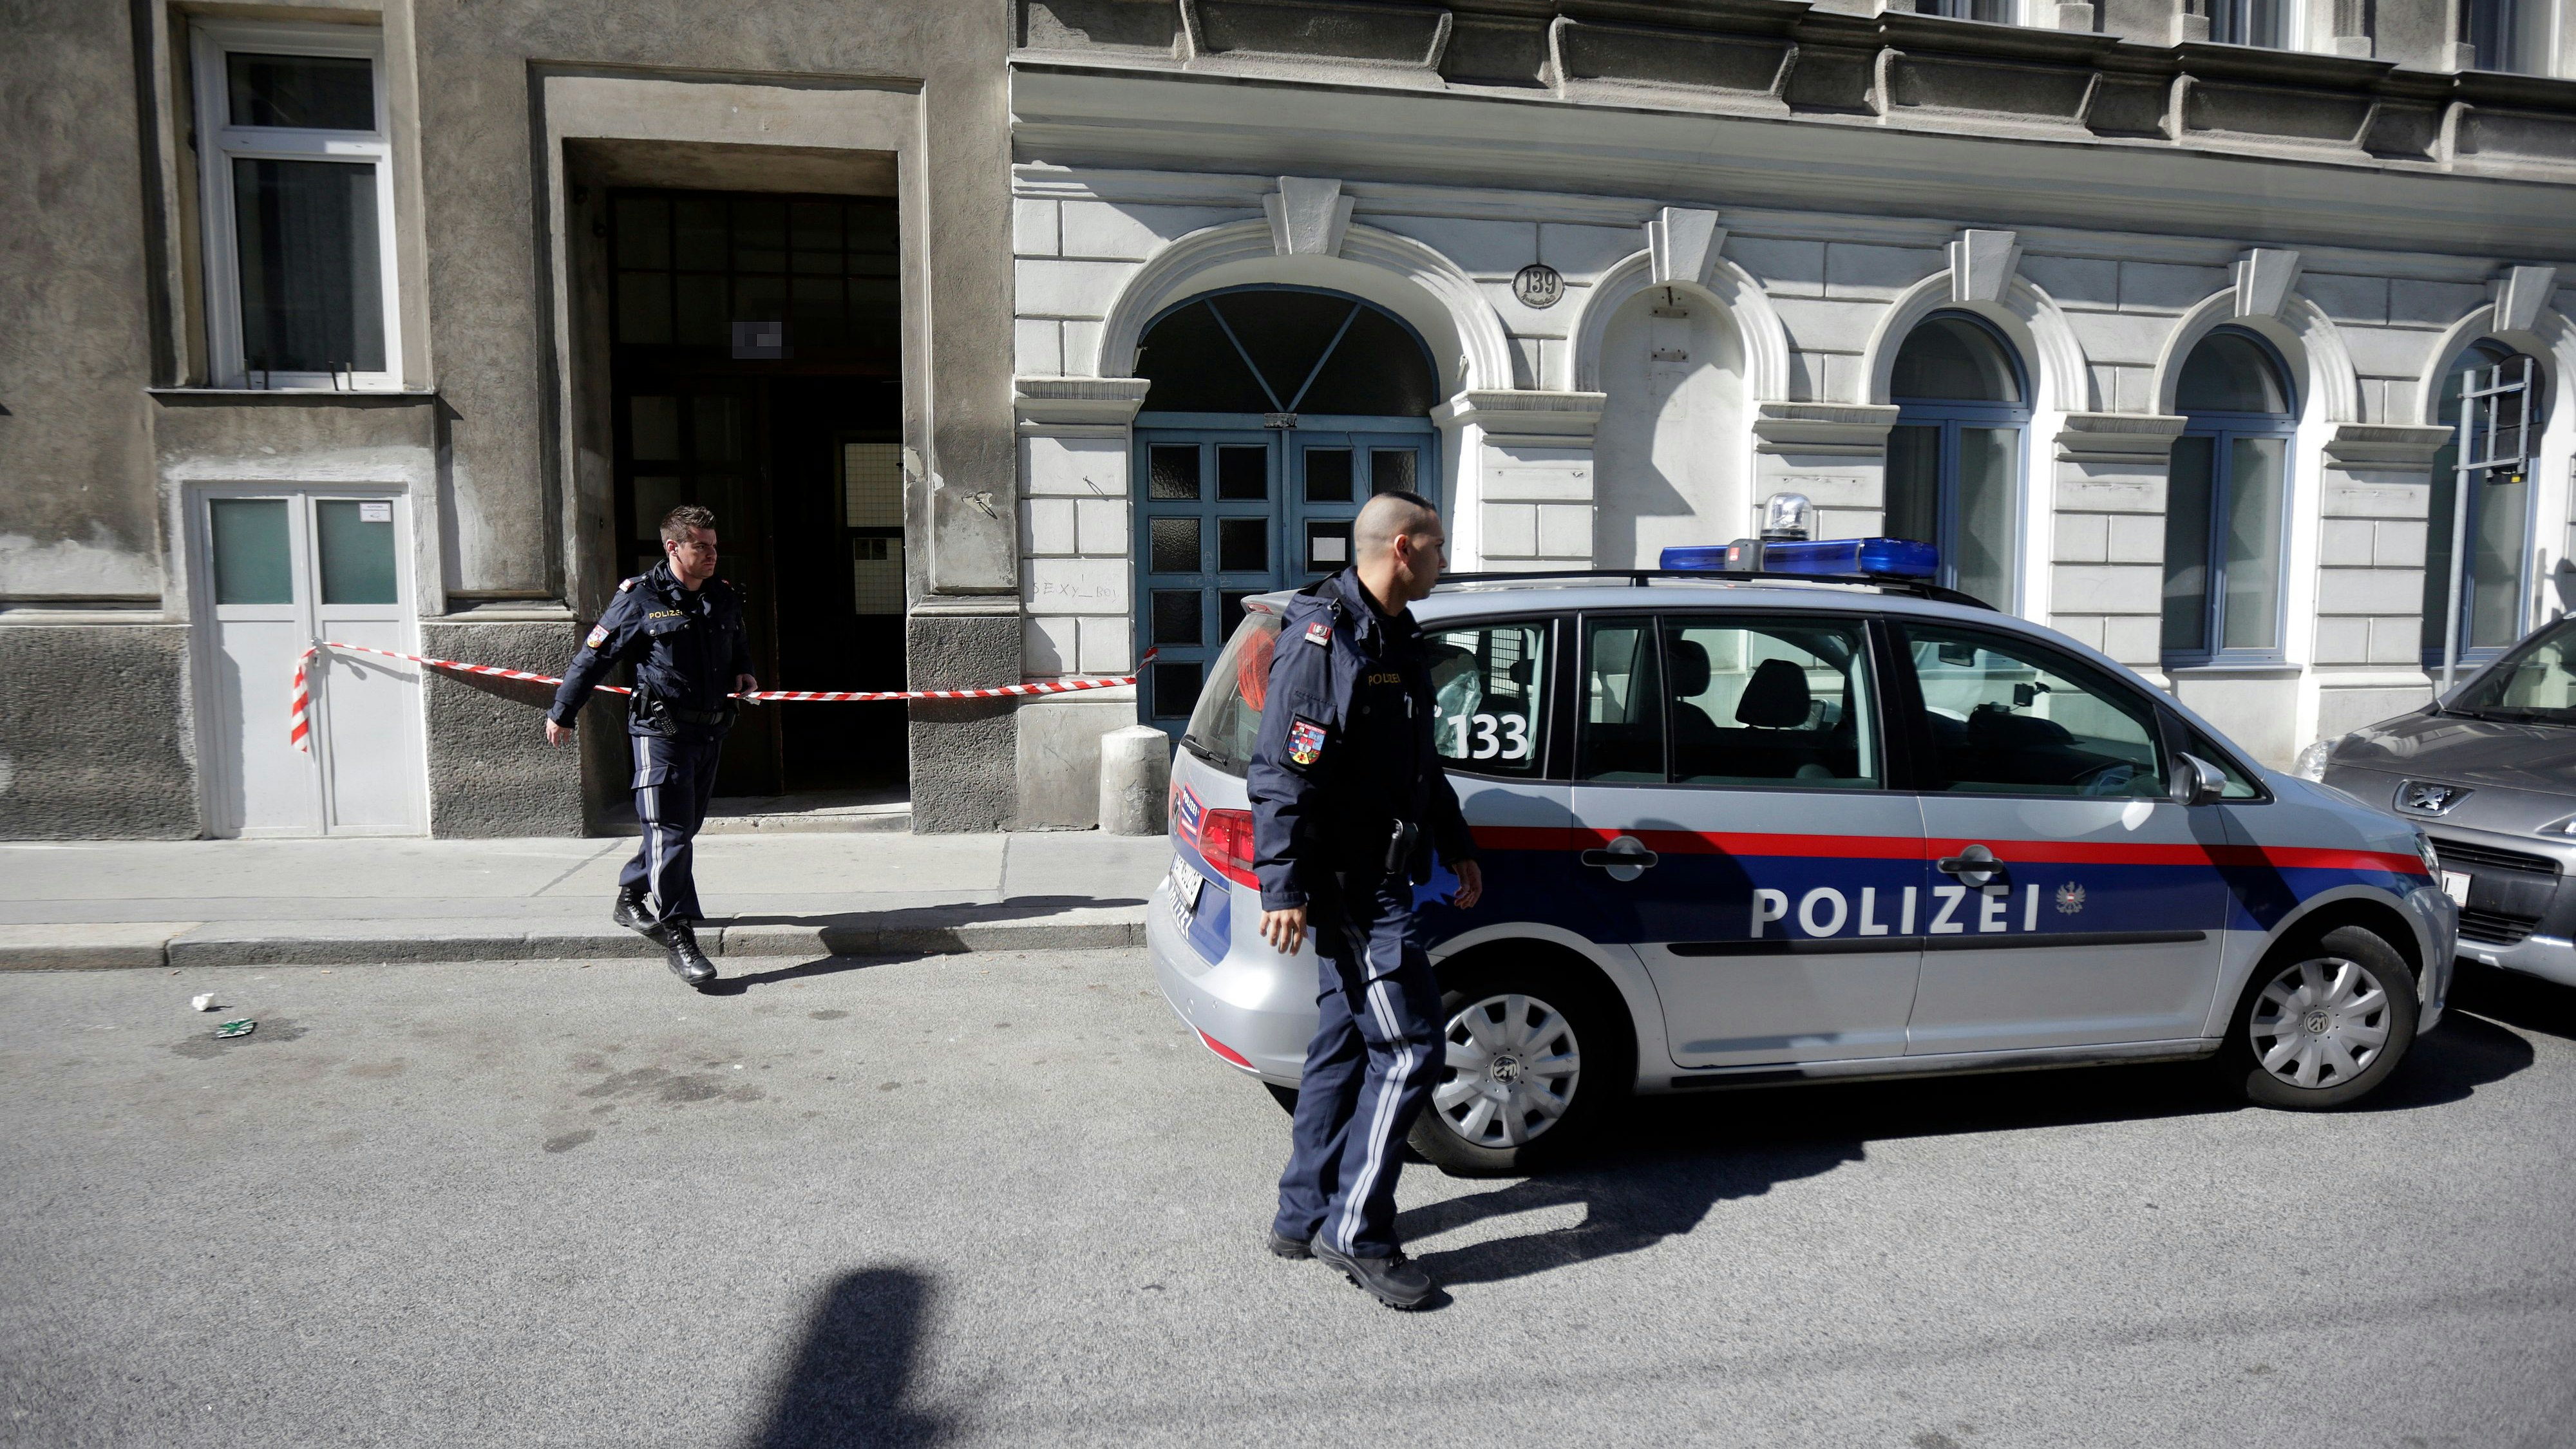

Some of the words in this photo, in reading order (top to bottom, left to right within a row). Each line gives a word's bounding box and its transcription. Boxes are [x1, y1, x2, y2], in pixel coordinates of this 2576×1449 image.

[1524, 270, 1556, 294] 139
[649, 609, 683, 620] POLIZEI
[1368, 672, 1401, 686] POLIZEI
[1447, 714, 1528, 759] 133
[1182, 790, 1198, 817] POLIZEI
[1750, 884, 2040, 938] POLIZEI
